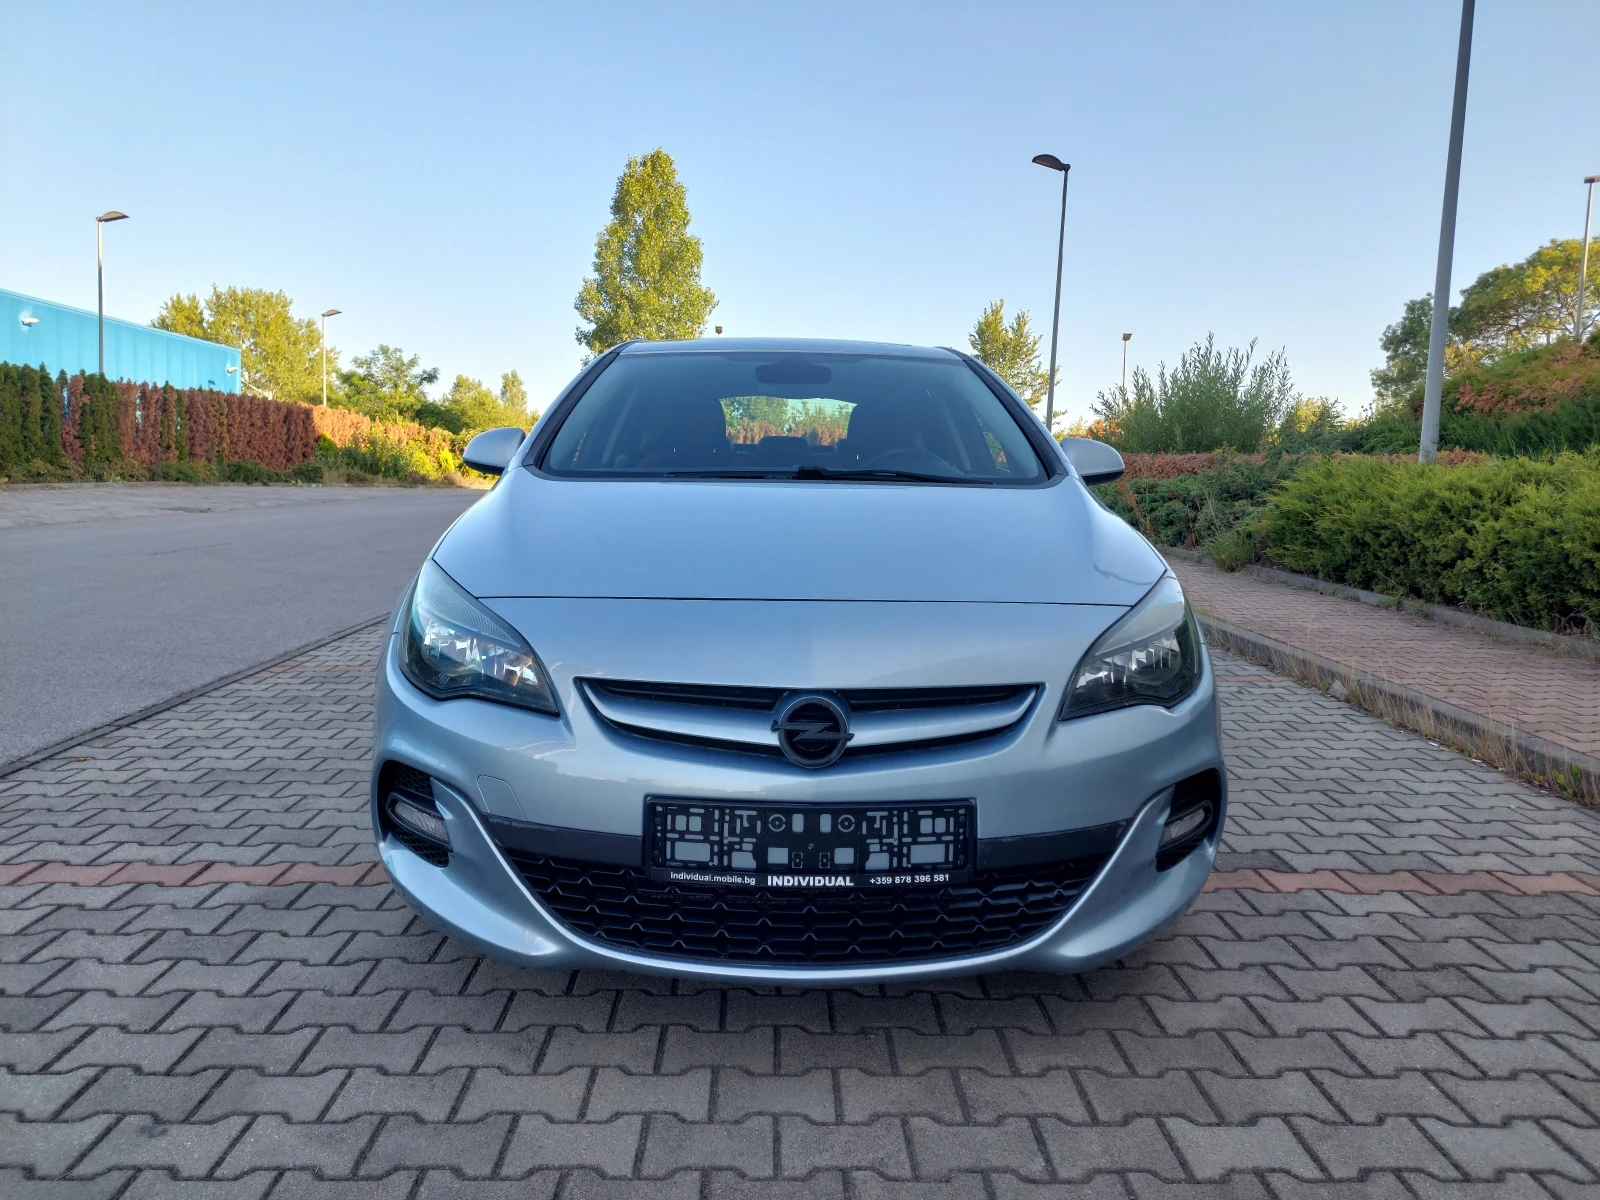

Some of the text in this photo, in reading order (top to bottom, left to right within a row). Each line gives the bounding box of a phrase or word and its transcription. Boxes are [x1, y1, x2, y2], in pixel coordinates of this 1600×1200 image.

[670, 871, 950, 887] individual.mobile.bg INDIVIDUAL +359 878 396 581
